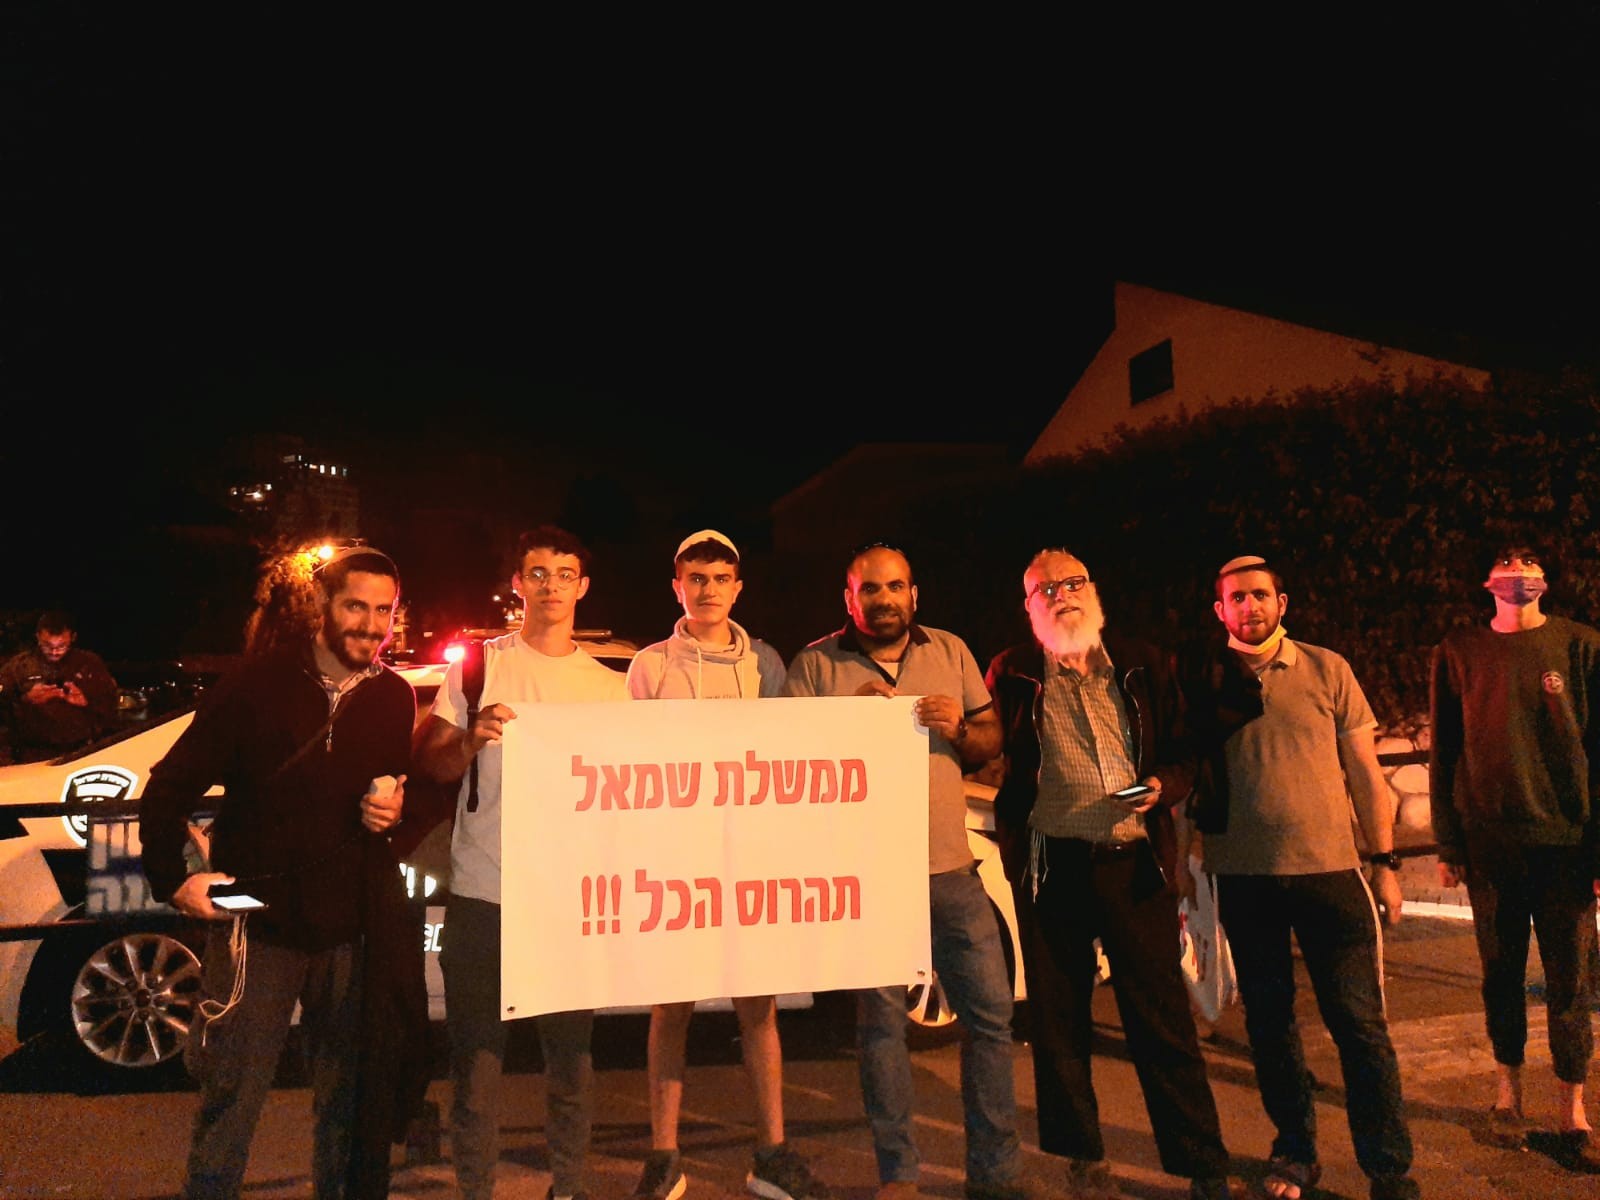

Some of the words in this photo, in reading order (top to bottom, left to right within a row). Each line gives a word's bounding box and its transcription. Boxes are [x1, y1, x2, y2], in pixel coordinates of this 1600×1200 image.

[571, 755, 702, 812] שמאל
[713, 750, 868, 807] ממשלת
[581, 874, 622, 937] !!!
[635, 869, 722, 933] הכל
[735, 875, 861, 927] תהרוס
